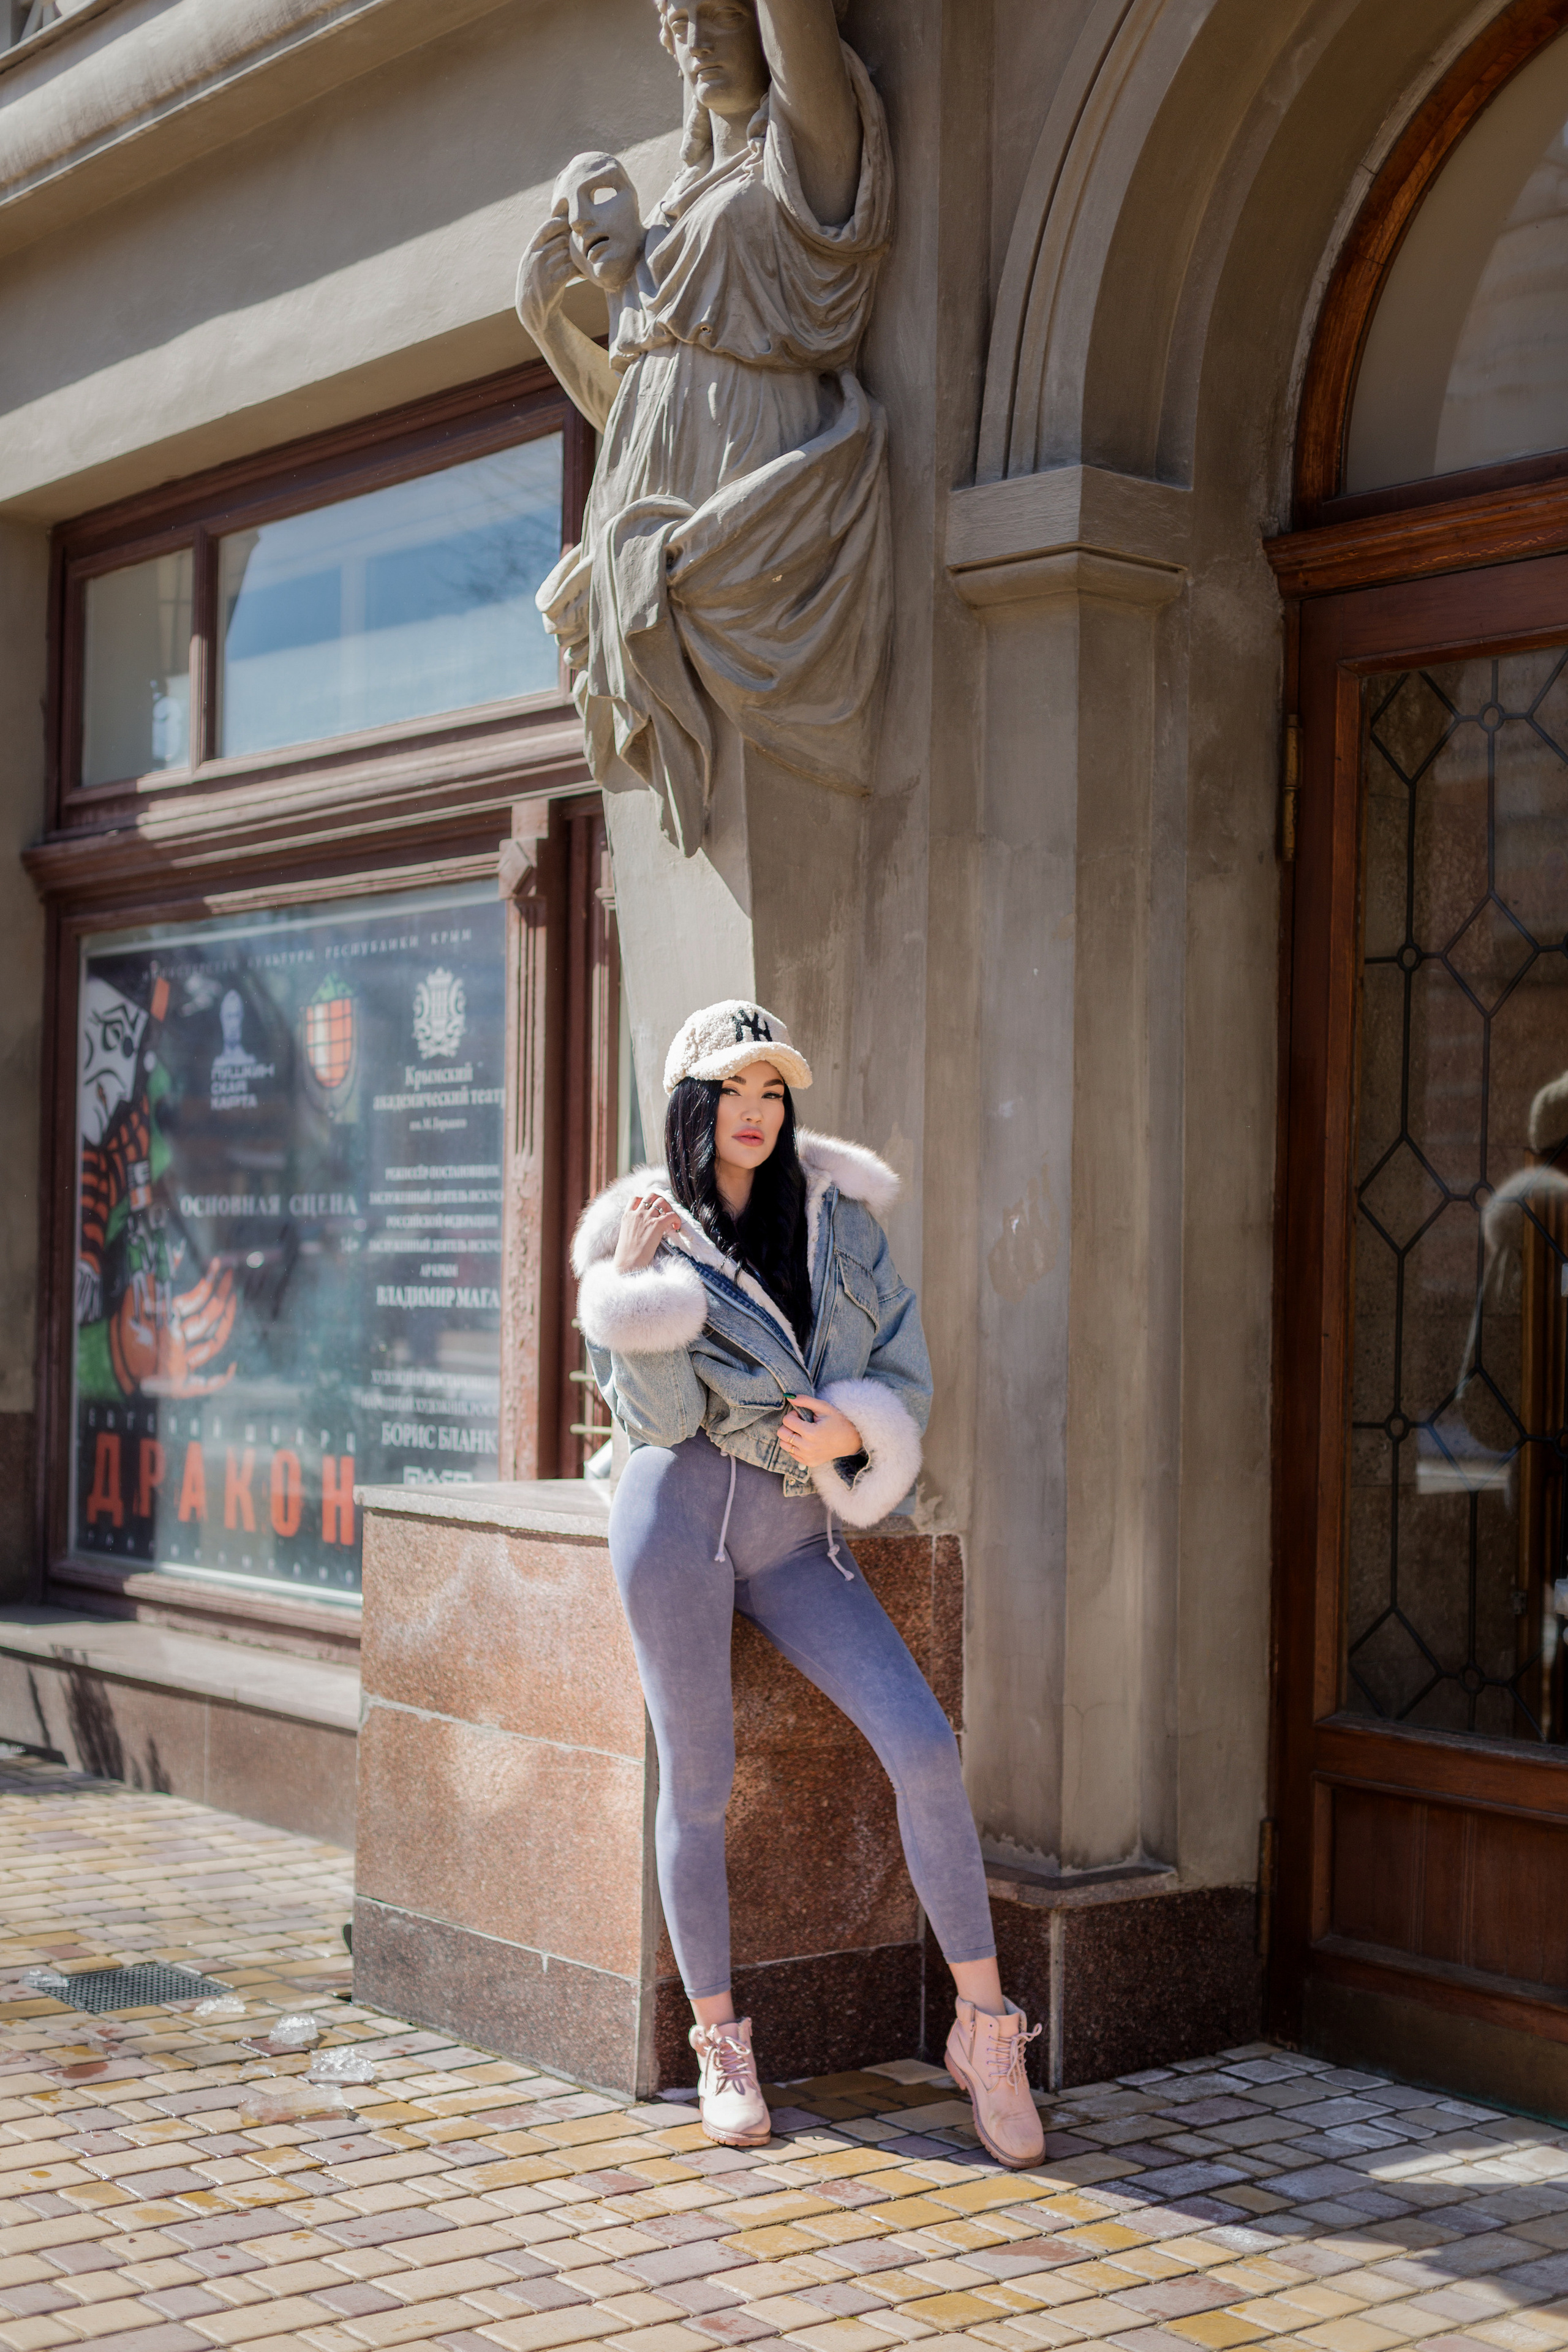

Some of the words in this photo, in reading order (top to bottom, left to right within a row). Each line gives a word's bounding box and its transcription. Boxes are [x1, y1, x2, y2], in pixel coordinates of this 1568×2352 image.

[325, 935, 420, 960] РЕСПУБЛИКИ
[431, 928, 472, 945] КРЫМ
[405, 1062, 473, 1091] Крымский
[372, 1085, 470, 1112] академический
[179, 1194, 280, 1218] ОСНОВНАЯ
[288, 1193, 359, 1219] СЦЕНА
[375, 1285, 456, 1311] ВЛАДИМИР
[245, 1423, 357, 1454] ШВАРЦ
[381, 1420, 437, 1450] БОРИС
[438, 1425, 499, 1455] БЛАНК
[86, 1432, 355, 1546] ДРАКОН
